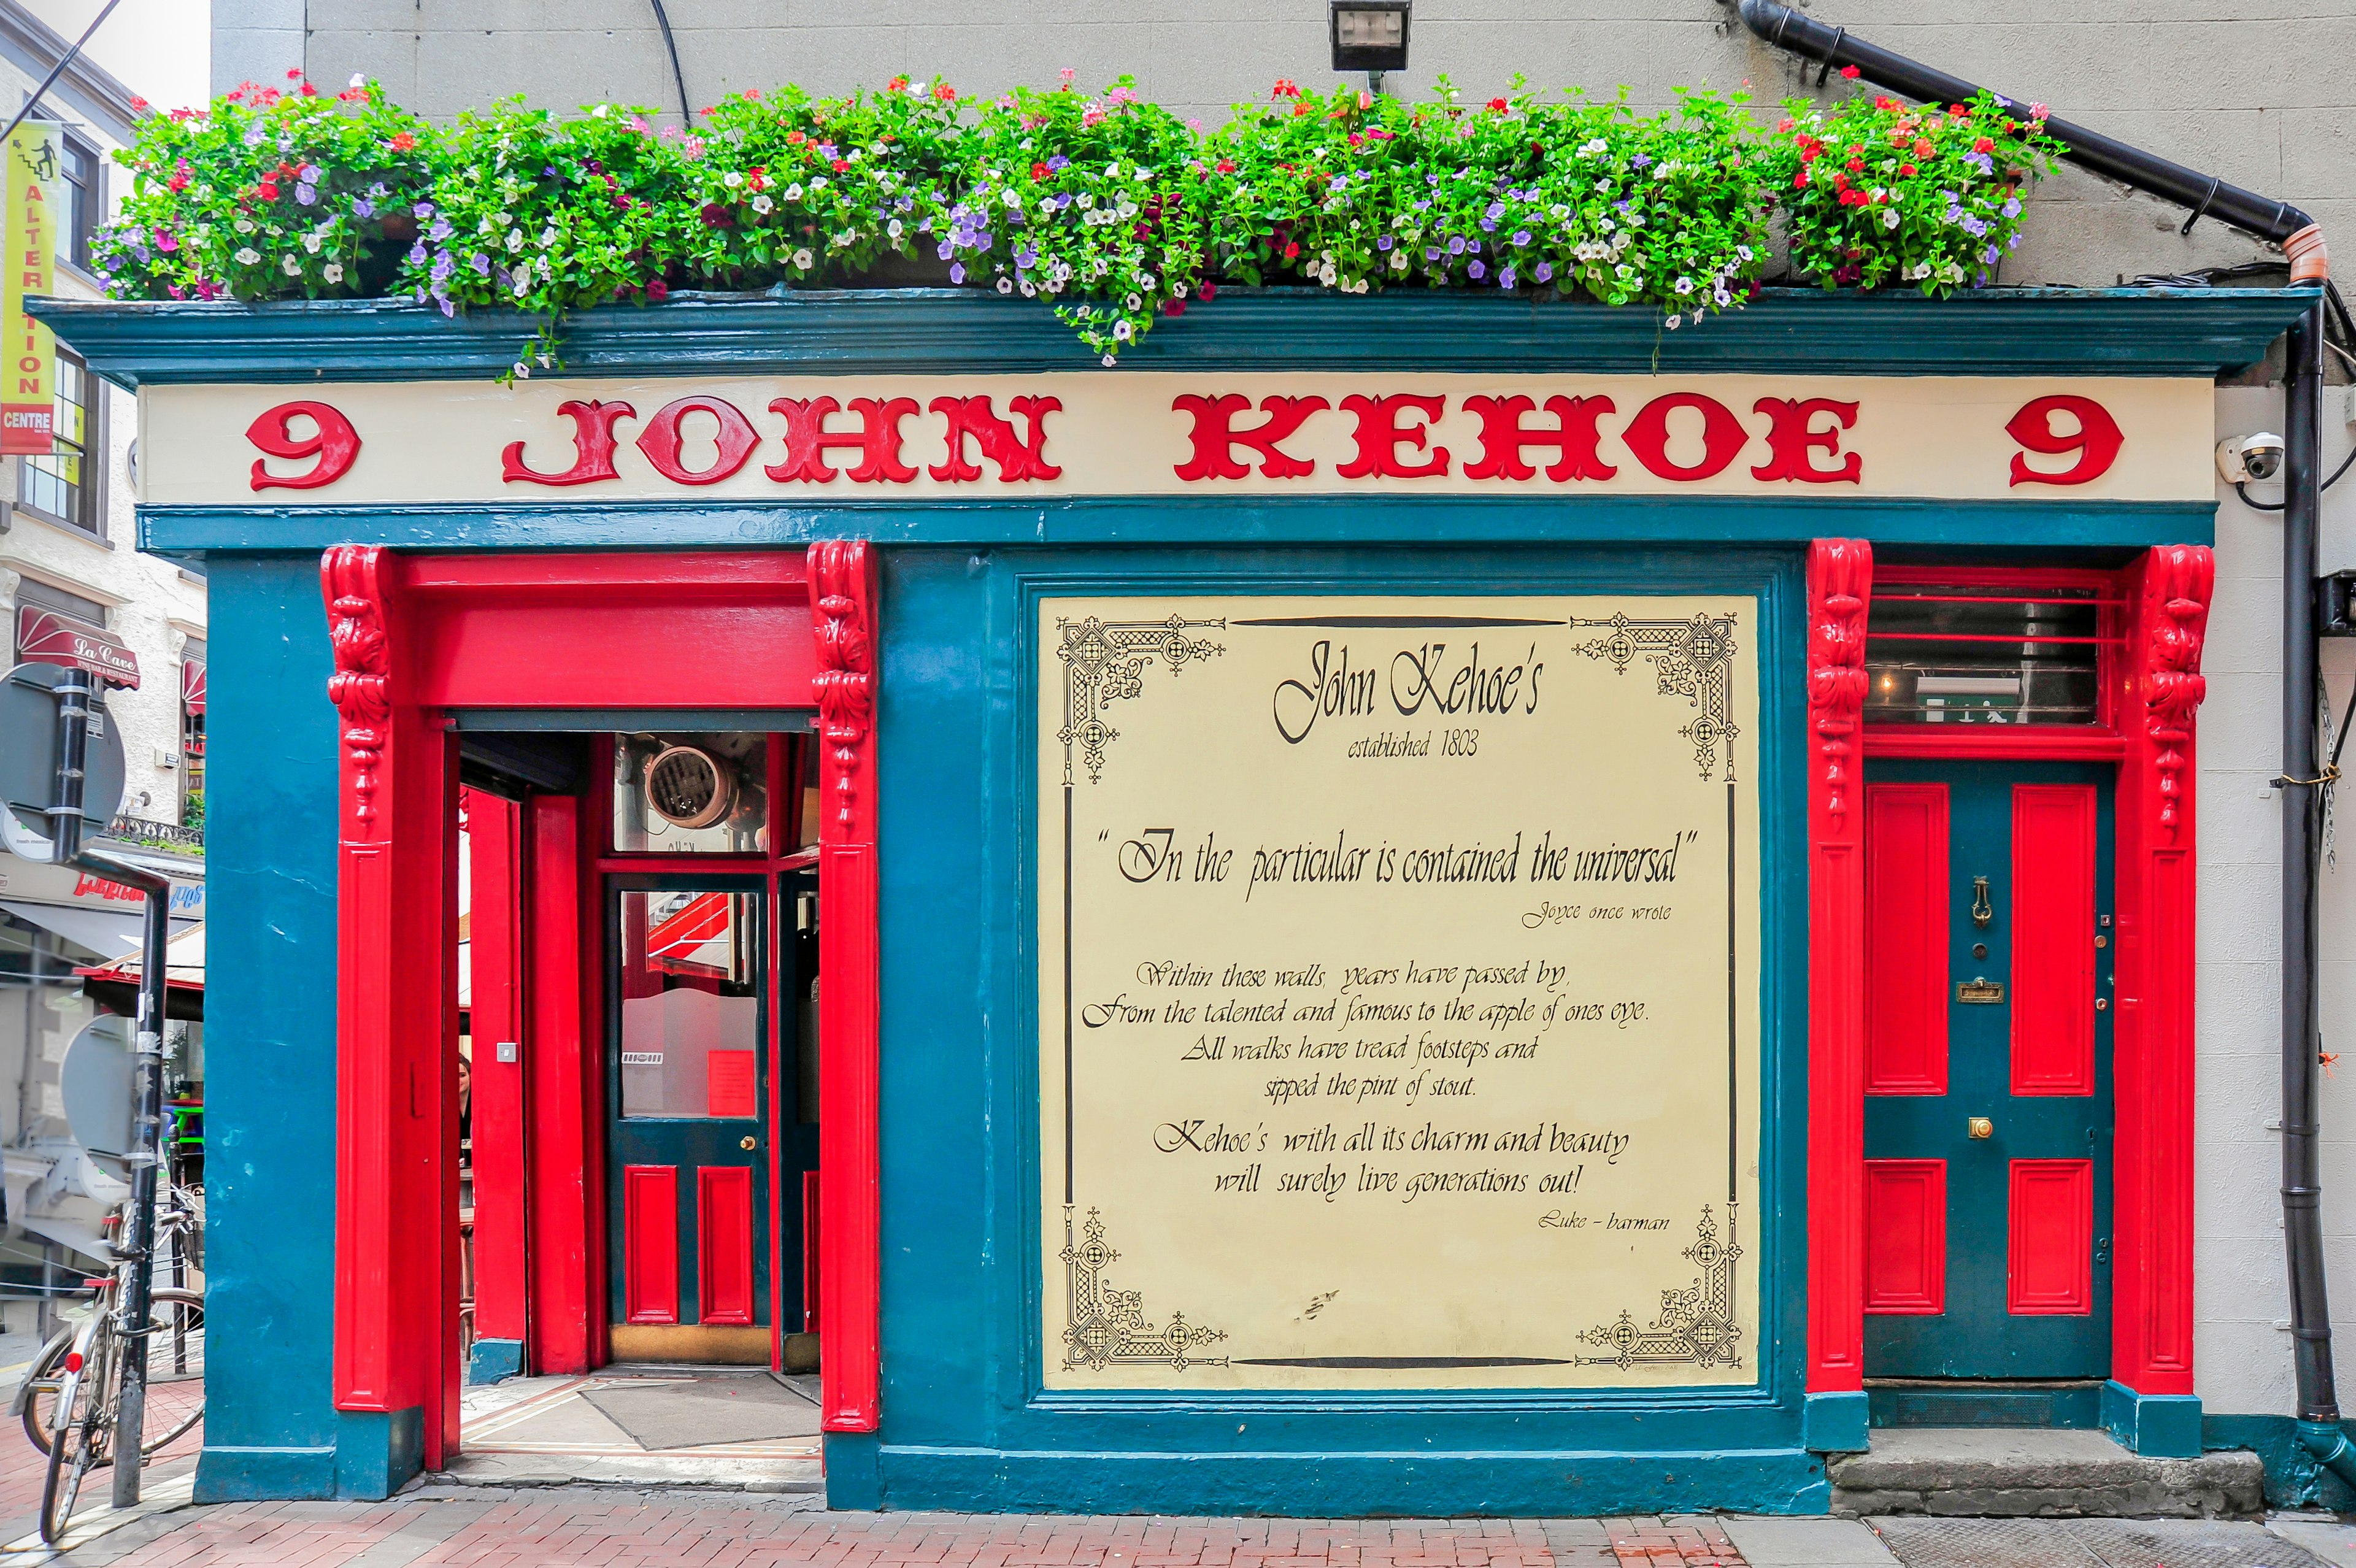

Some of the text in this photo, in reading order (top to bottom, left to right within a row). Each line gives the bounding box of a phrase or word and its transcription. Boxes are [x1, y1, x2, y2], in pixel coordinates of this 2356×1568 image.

[19, 185, 44, 394] ALTERTION
[4, 411, 50, 428] CENTRE
[245, 392, 2125, 491] 9 JOHN KEHOE 9
[74, 638, 136, 671] La Cave
[106, 669, 138, 683] RESTAURANT
[1273, 640, 1544, 745] John Kehoe's
[1348, 728, 1479, 758] established 1803
[1195, 831, 1233, 882] the
[1245, 828, 1371, 903] particular
[1376, 840, 1396, 883] is
[1402, 830, 1522, 883] contained
[1530, 829, 1569, 883] the
[1522, 901, 1671, 929] Joyce once wrote
[1136, 959, 1570, 995] Within these walls, years have passed by,
[1082, 993, 1649, 1032] From the talented and famous to the apple of ones eye.
[1180, 1030, 1539, 1070] All walks have tread footsteps and
[1264, 1068, 1476, 1107] sipped the pint of stout.
[1153, 1119, 1629, 1165] Kehoe's with all its charm and beauty
[1214, 1163, 1584, 1204] will surely live generations out!
[1538, 1209, 1587, 1228] Luke
[1606, 1212, 1670, 1231] barman
